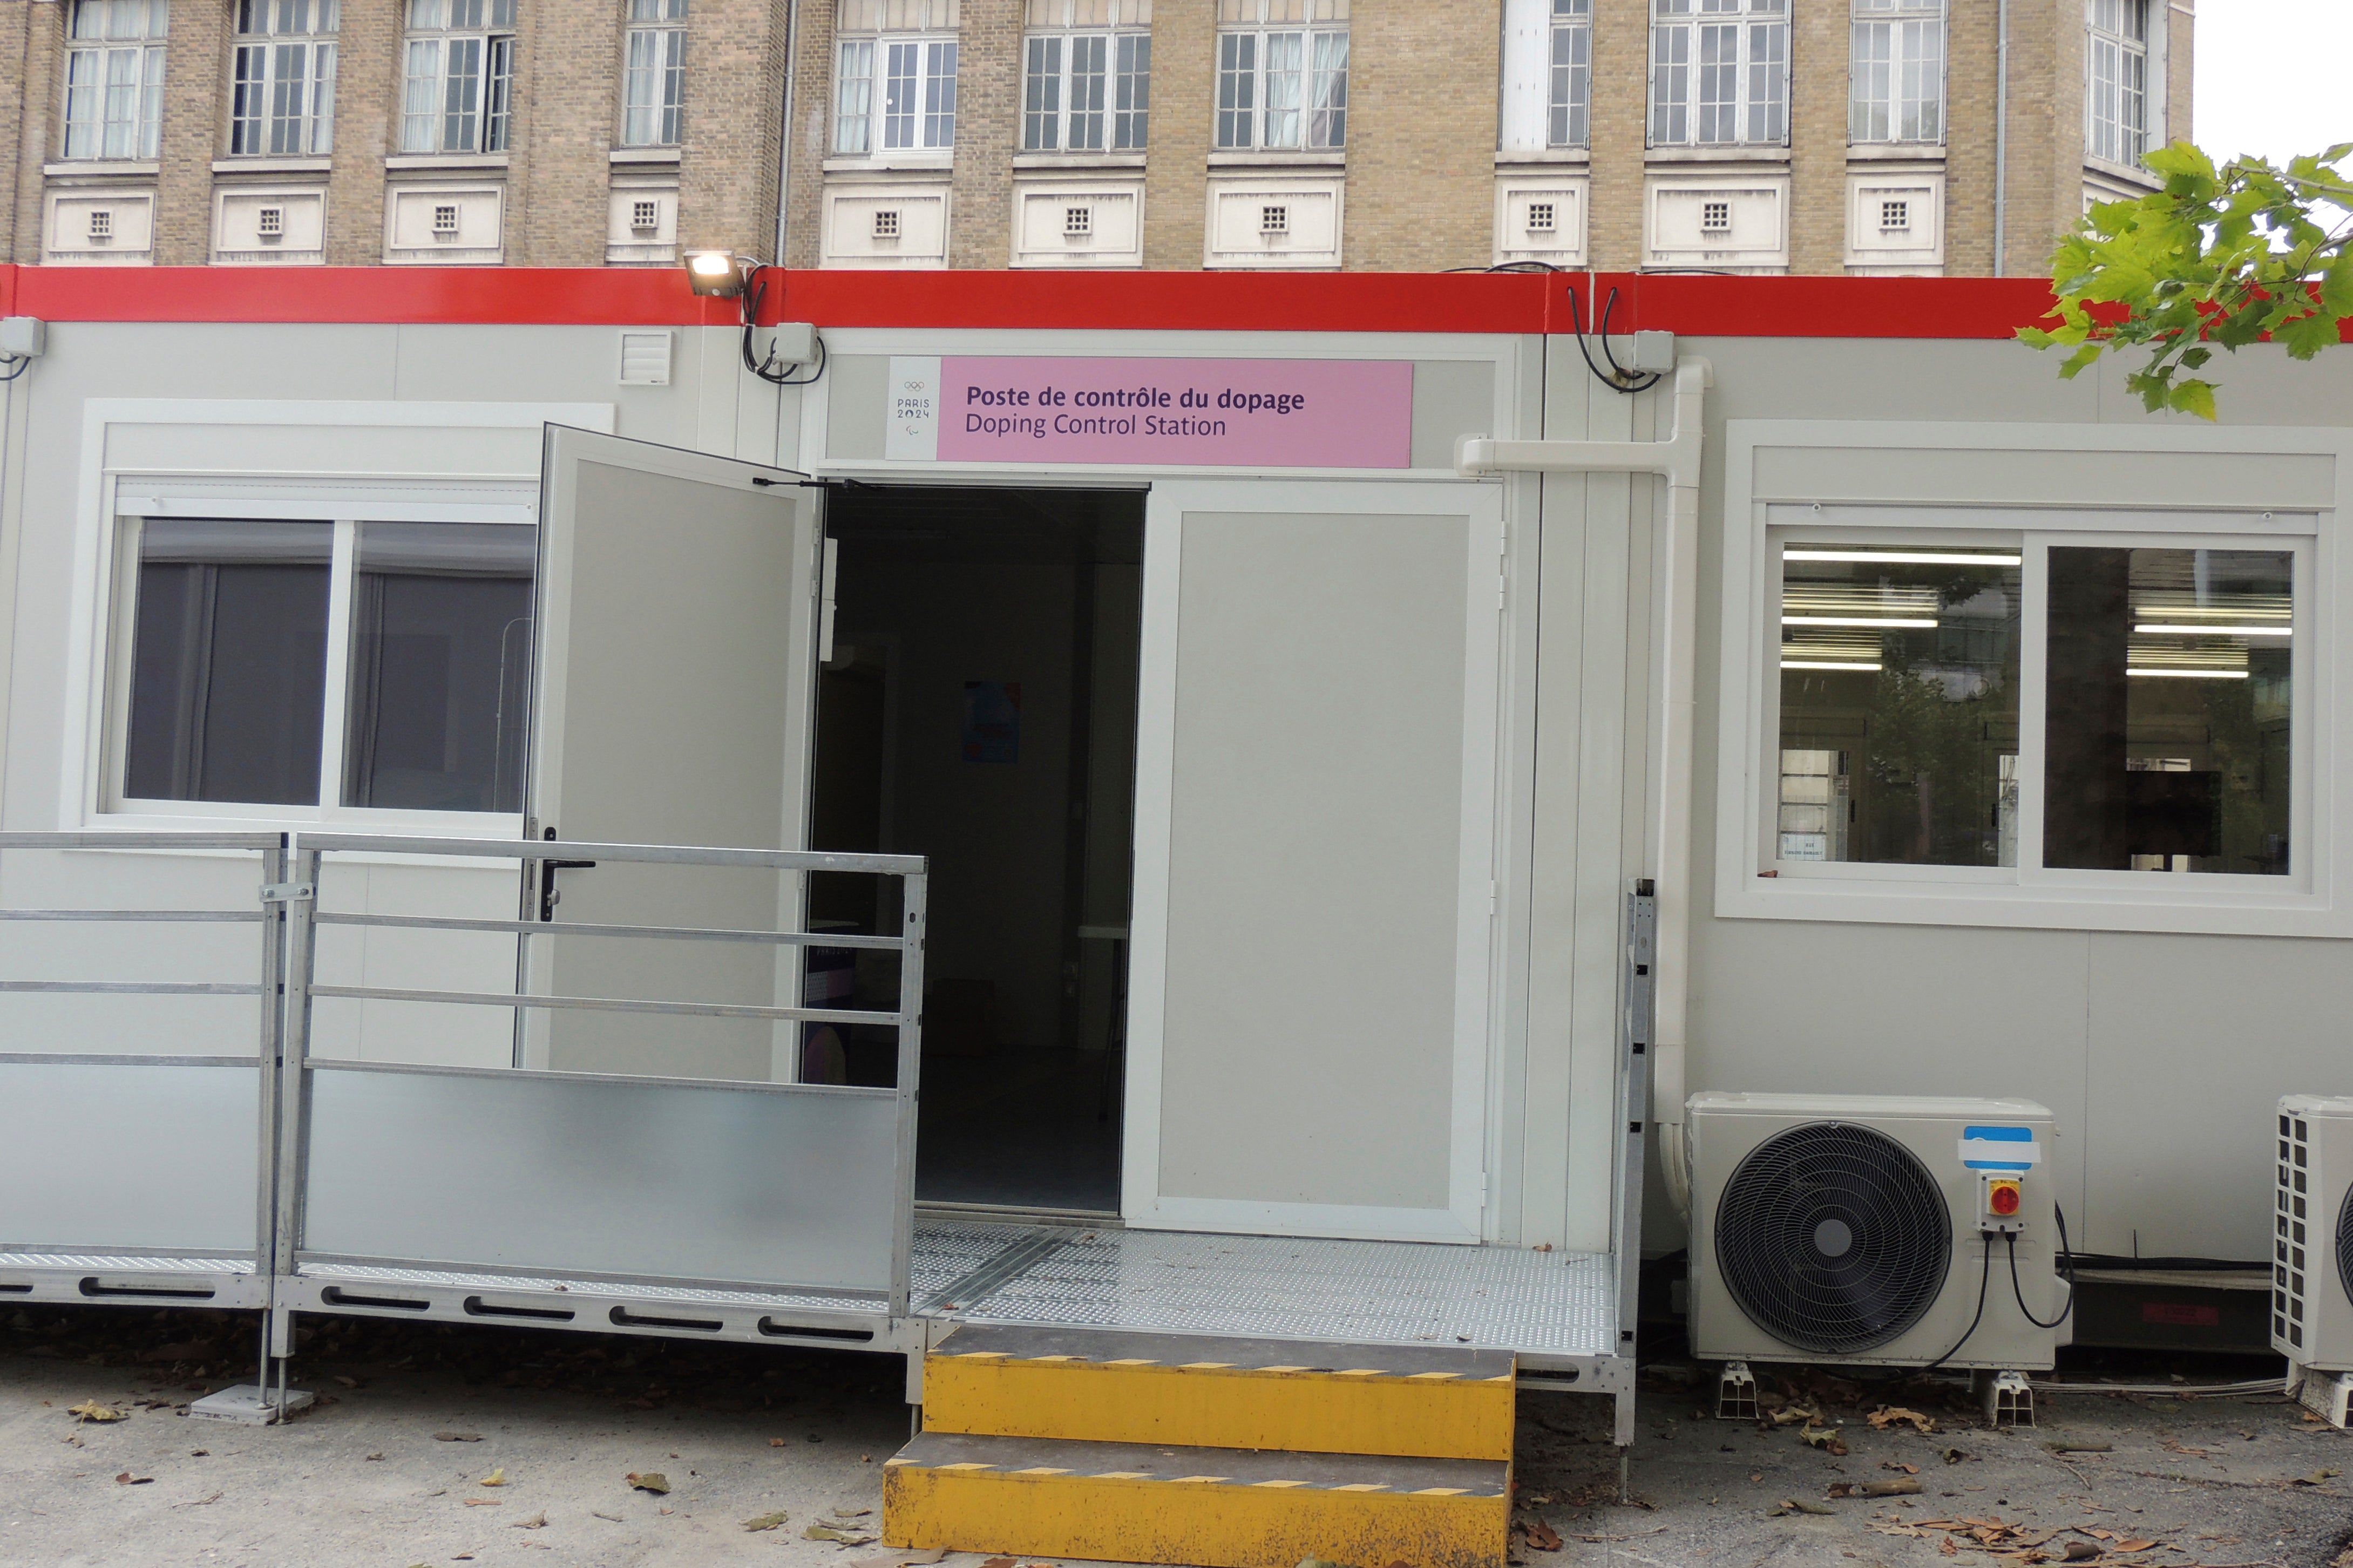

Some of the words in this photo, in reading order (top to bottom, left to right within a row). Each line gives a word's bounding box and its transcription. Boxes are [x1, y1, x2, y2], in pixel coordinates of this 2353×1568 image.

[898, 399, 930, 408] PARIS
[967, 386, 1030, 405] Poste
[1038, 386, 1066, 406] de
[1074, 387, 1171, 408] contrôle
[1179, 388, 1209, 408] du
[1217, 388, 1305, 414] dopage
[898, 409, 929, 418] 2024
[966, 413, 1046, 438] Doping
[1054, 414, 1136, 434] Control
[1145, 415, 1225, 436] Station
